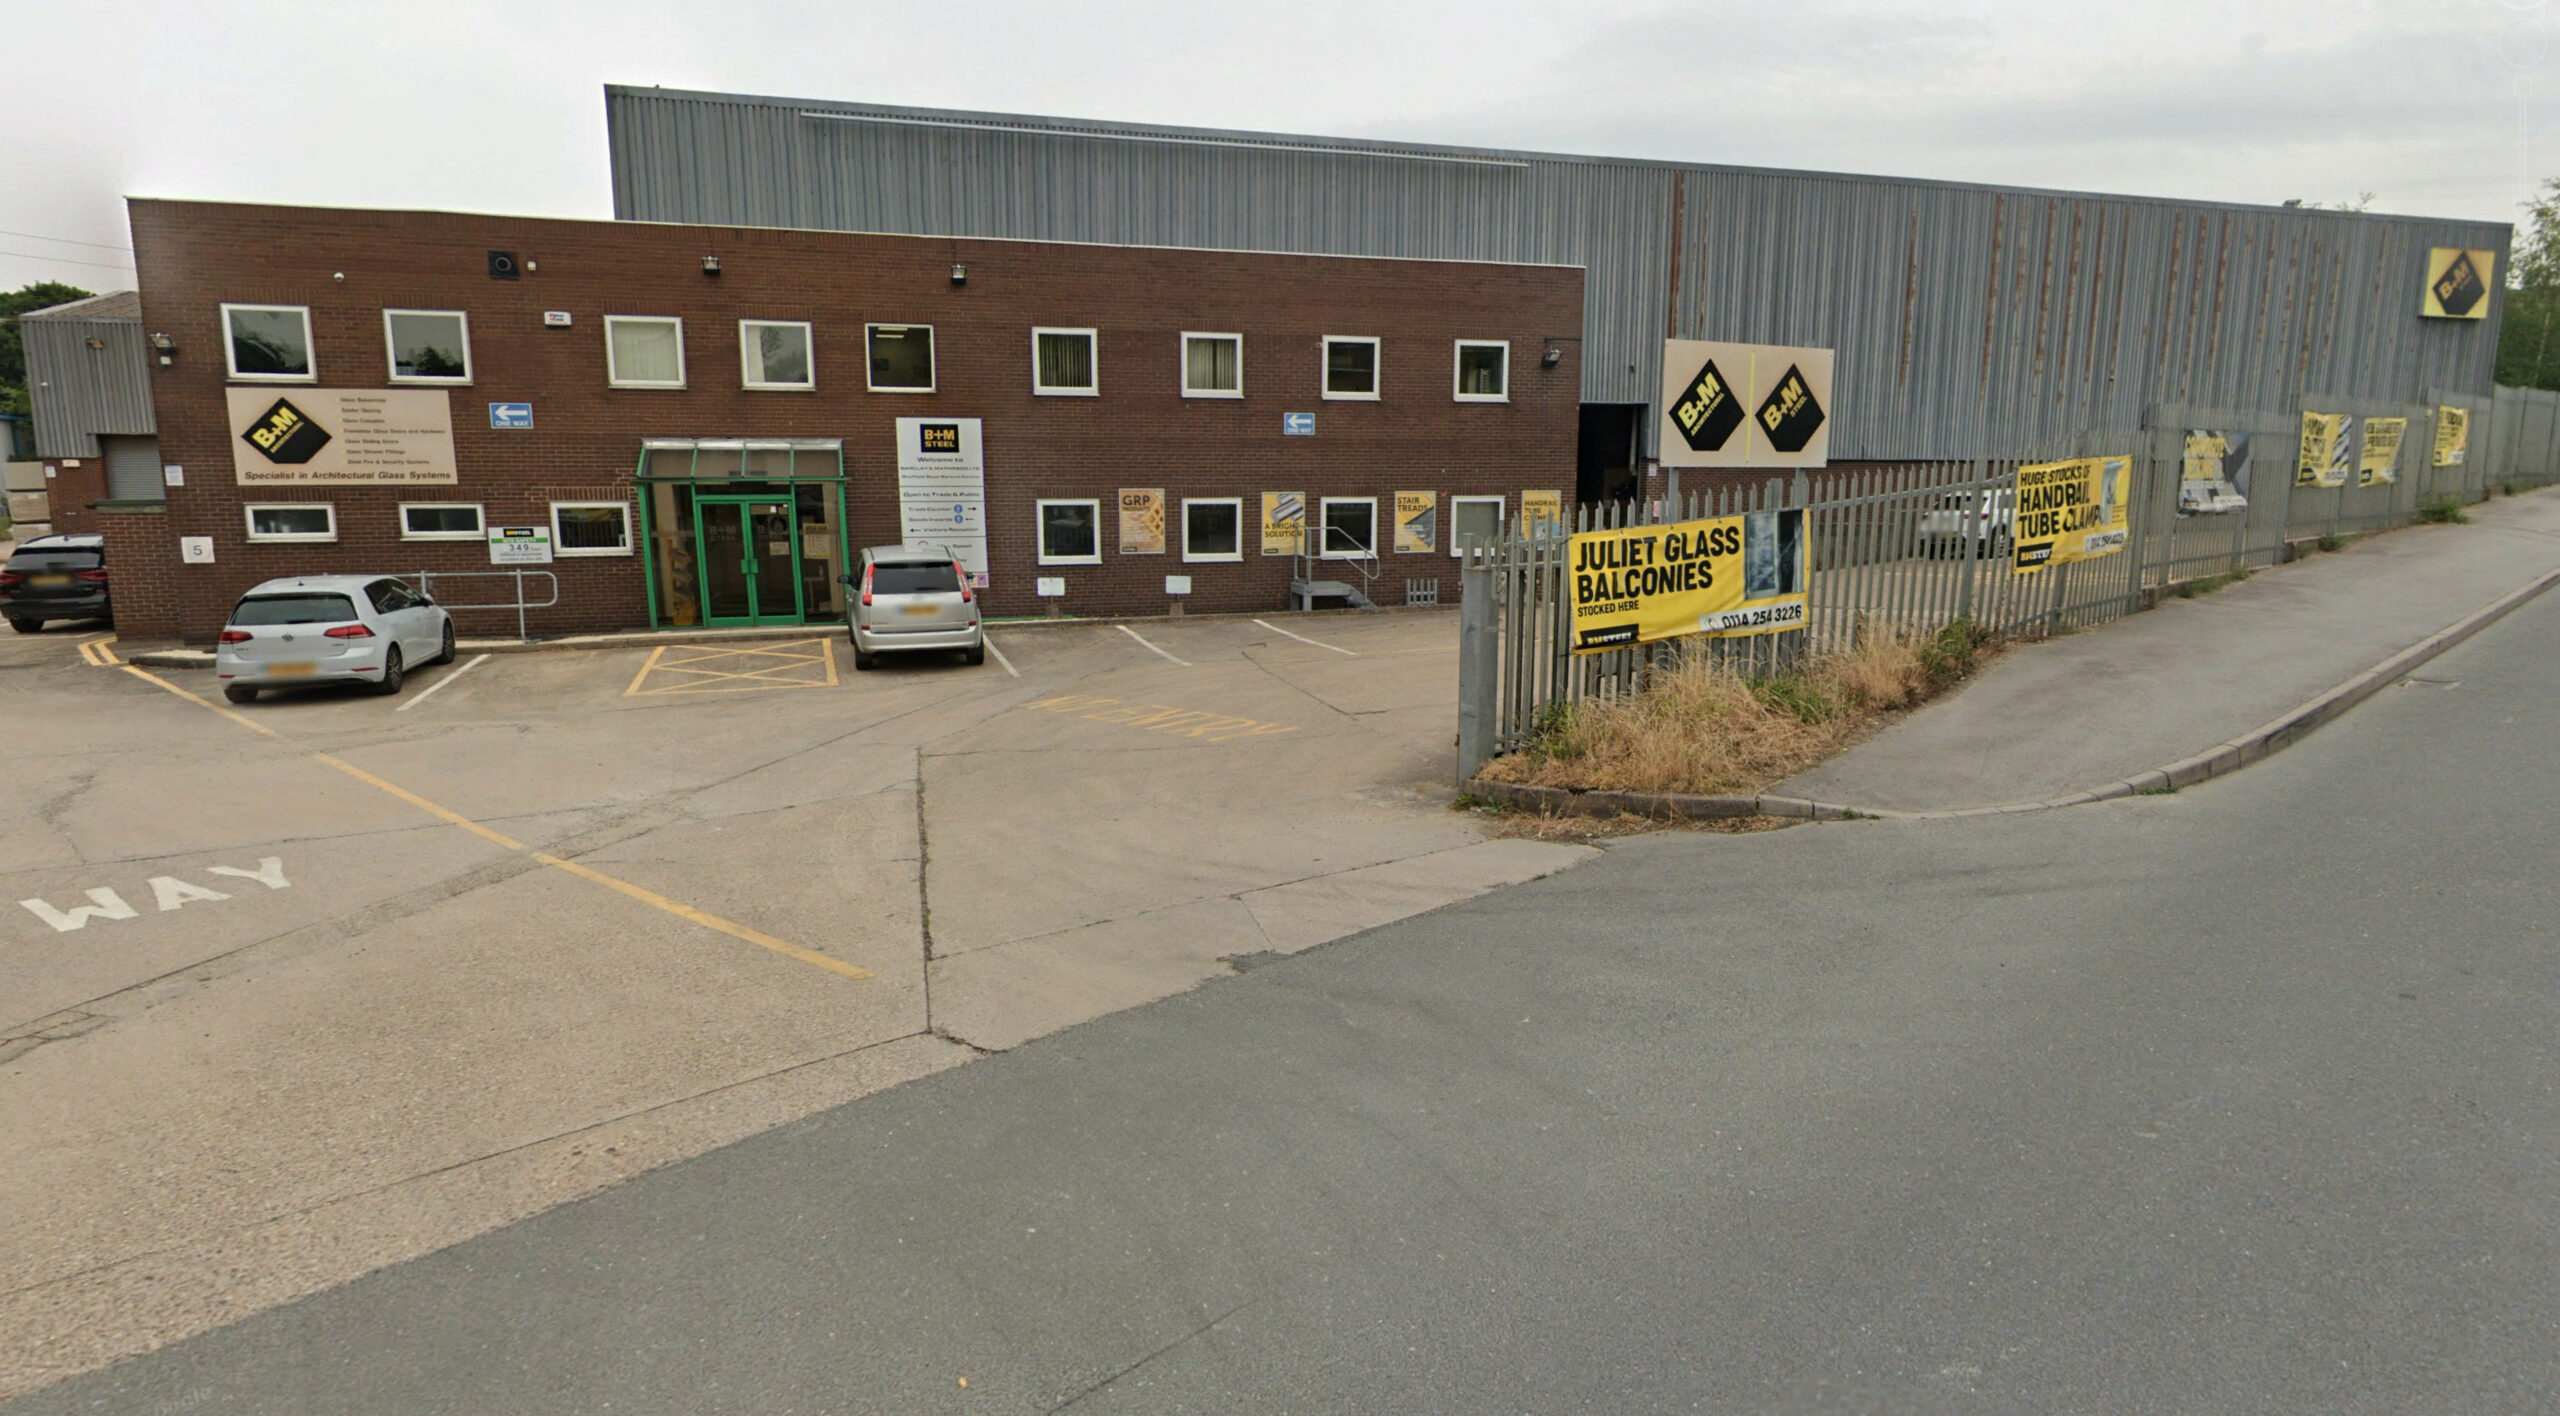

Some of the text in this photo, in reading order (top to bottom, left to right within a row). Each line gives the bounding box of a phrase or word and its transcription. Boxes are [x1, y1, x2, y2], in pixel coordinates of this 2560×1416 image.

[1678, 372, 1720, 430] B+M
[1763, 376, 1803, 431] B+M
[251, 406, 298, 449] B+M
[924, 429, 955, 440] B+M
[924, 440, 956, 448] STEEL
[244, 471, 451, 481] Specialist in Architectural Glass Systems
[2020, 470, 2047, 487] HUGE
[2048, 465, 2082, 484] STOCKS
[1122, 495, 1151, 506] GRP
[1397, 497, 1420, 505] STAIR
[2020, 481, 2091, 514] HANDRAIL
[2019, 511, 2060, 540] TUBE
[192, 544, 203, 556] 5
[509, 543, 529, 552] 349
[1575, 525, 1741, 573] JULIET GLASS
[1577, 560, 1713, 604] BALCONIES
[1578, 600, 1639, 618] STOCKED HERE
[1722, 604, 1802, 630] 0114 254 3226
[19, 856, 292, 932] WAY
